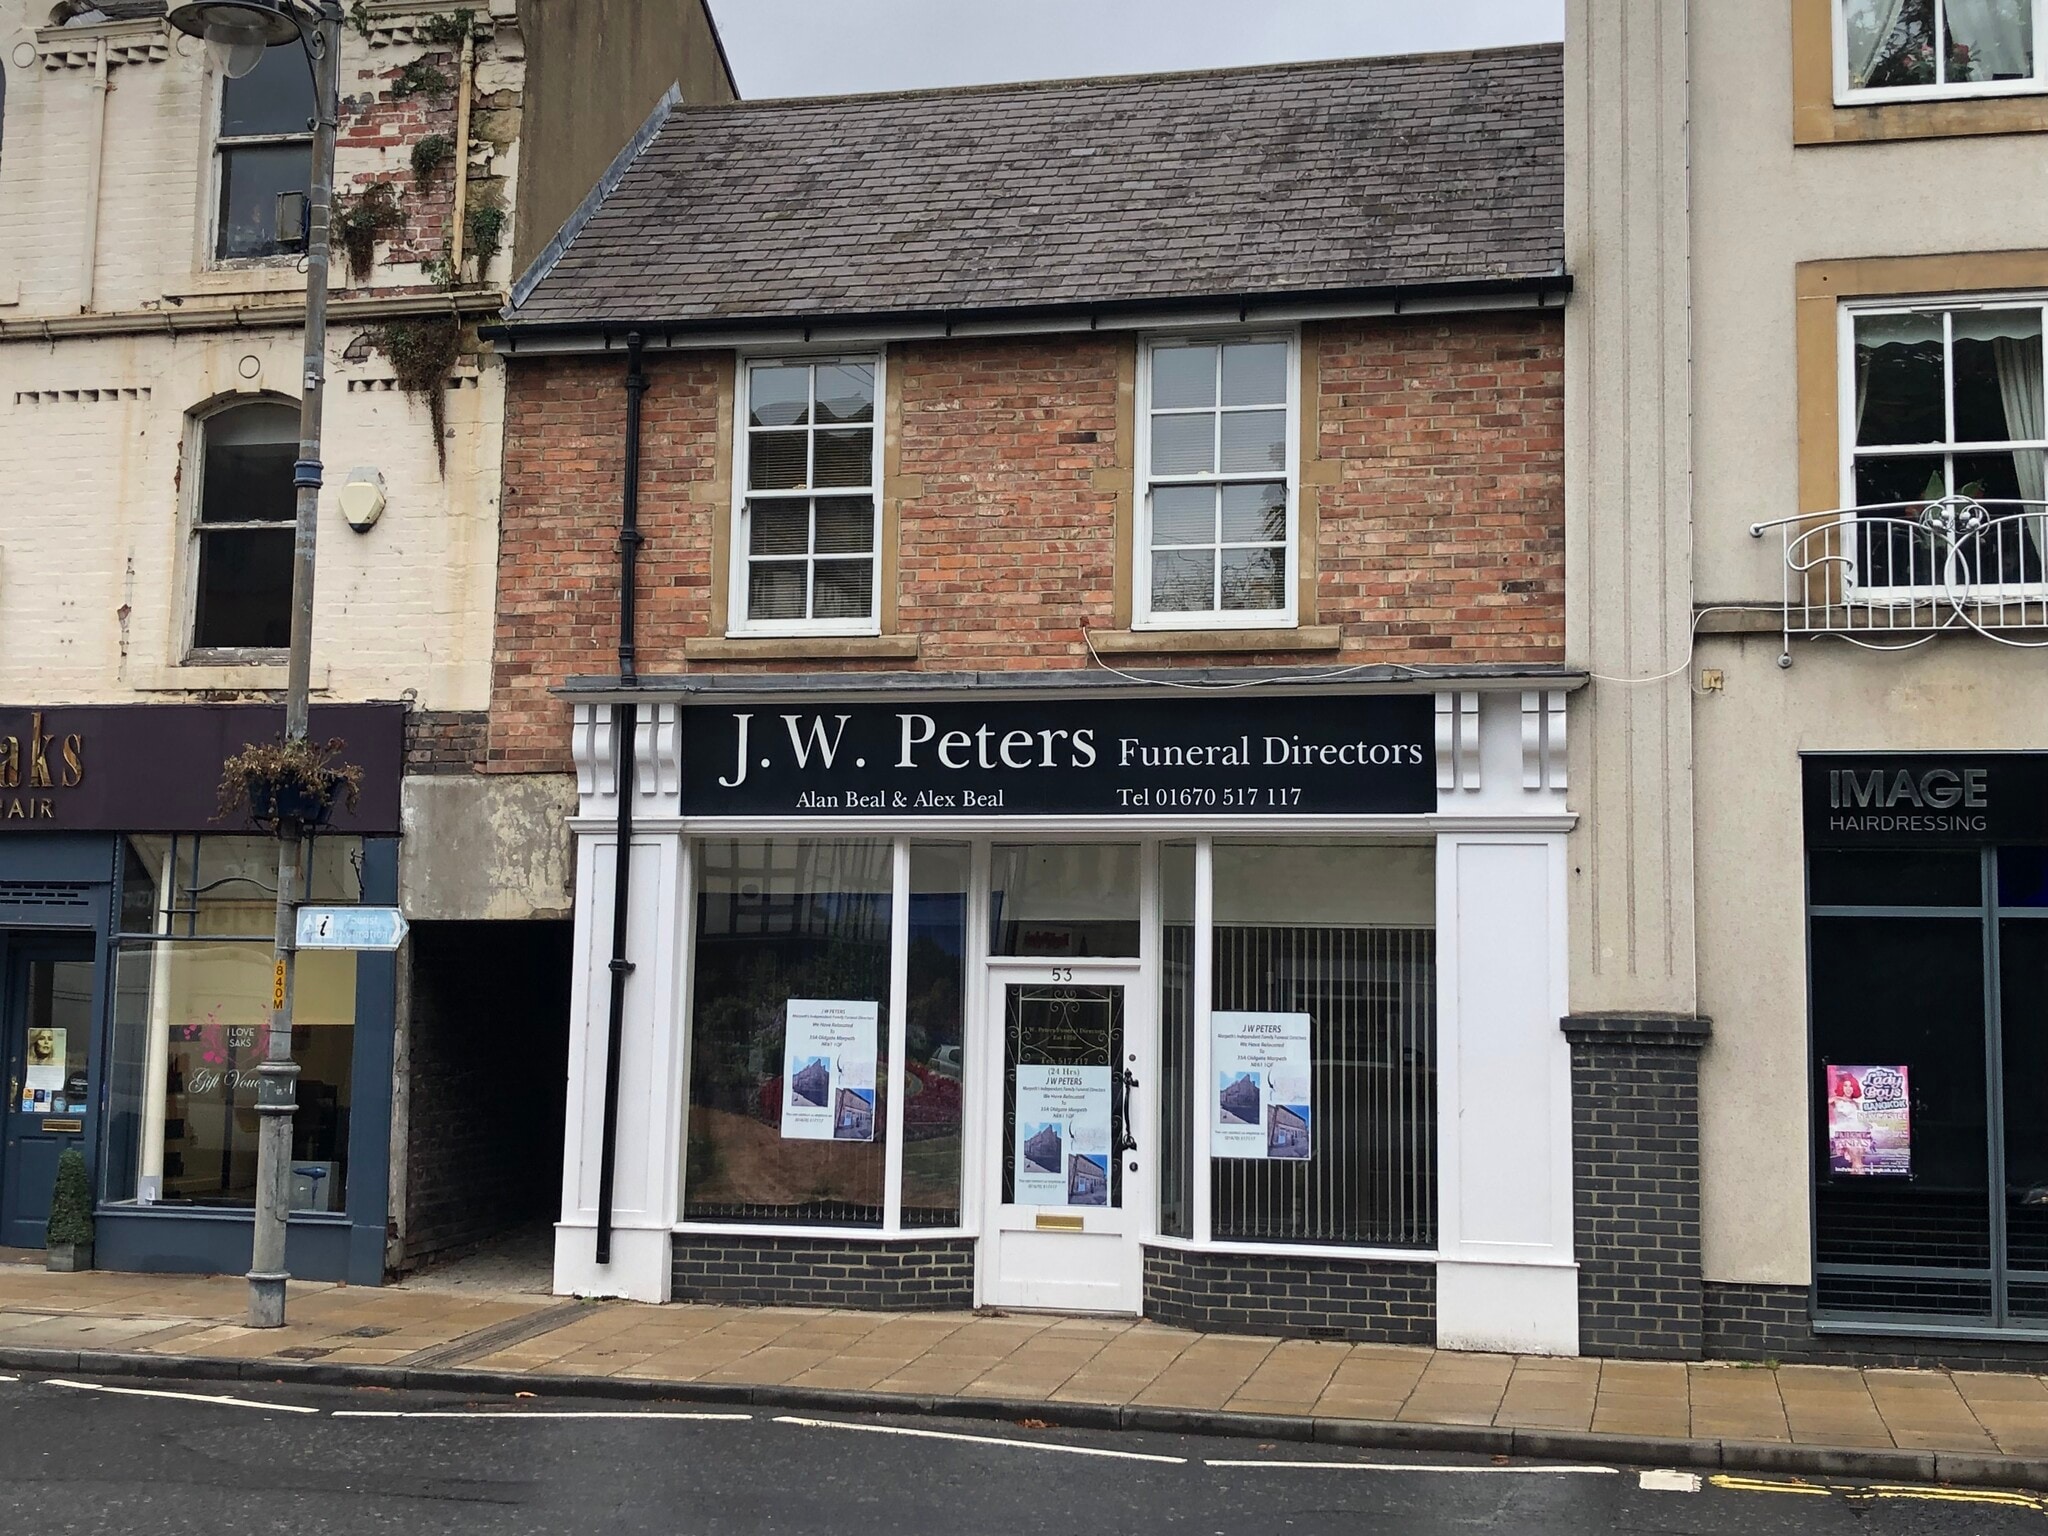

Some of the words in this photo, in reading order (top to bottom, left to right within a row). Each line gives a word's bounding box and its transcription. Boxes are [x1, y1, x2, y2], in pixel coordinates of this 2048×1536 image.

[894, 713, 1097, 770] Peters
[1118, 735, 1250, 766] Funeral
[1262, 734, 1424, 766] Directors
[1830, 768, 1988, 809] IMAGE
[796, 791, 839, 809] Alan
[845, 790, 886, 809] Beal
[891, 791, 908, 809] &
[913, 790, 955, 808] Alex
[963, 789, 1004, 808] Beal
[1116, 788, 1149, 806] Tel
[1156, 788, 1216, 806] 01670
[1222, 787, 1258, 806] 517
[1268, 787, 1302, 806] 117
[1830, 815, 1988, 831] HAIRDRESSING
[345, 914, 379, 925] Tourist
[1051, 967, 1073, 982] 53
[226, 1028, 230, 1037] I
[231, 1027, 255, 1037] LOVE
[1242, 1024, 1246, 1033] J
[1247, 1024, 1255, 1033] W
[1255, 1024, 1282, 1033] PETERS
[229, 1038, 252, 1047] SAKS
[1048, 1067, 1060, 1076] (24
[1062, 1068, 1080, 1076] Hrs)
[188, 1067, 220, 1094] Gift
[1045, 1077, 1050, 1085] J
[1050, 1077, 1058, 1085] W
[1058, 1077, 1082, 1086] PETERS
[1863, 1072, 1903, 1089] Lady
[1864, 1085, 1902, 1100] Boys
[1863, 1100, 1907, 1111] BANGKOK
